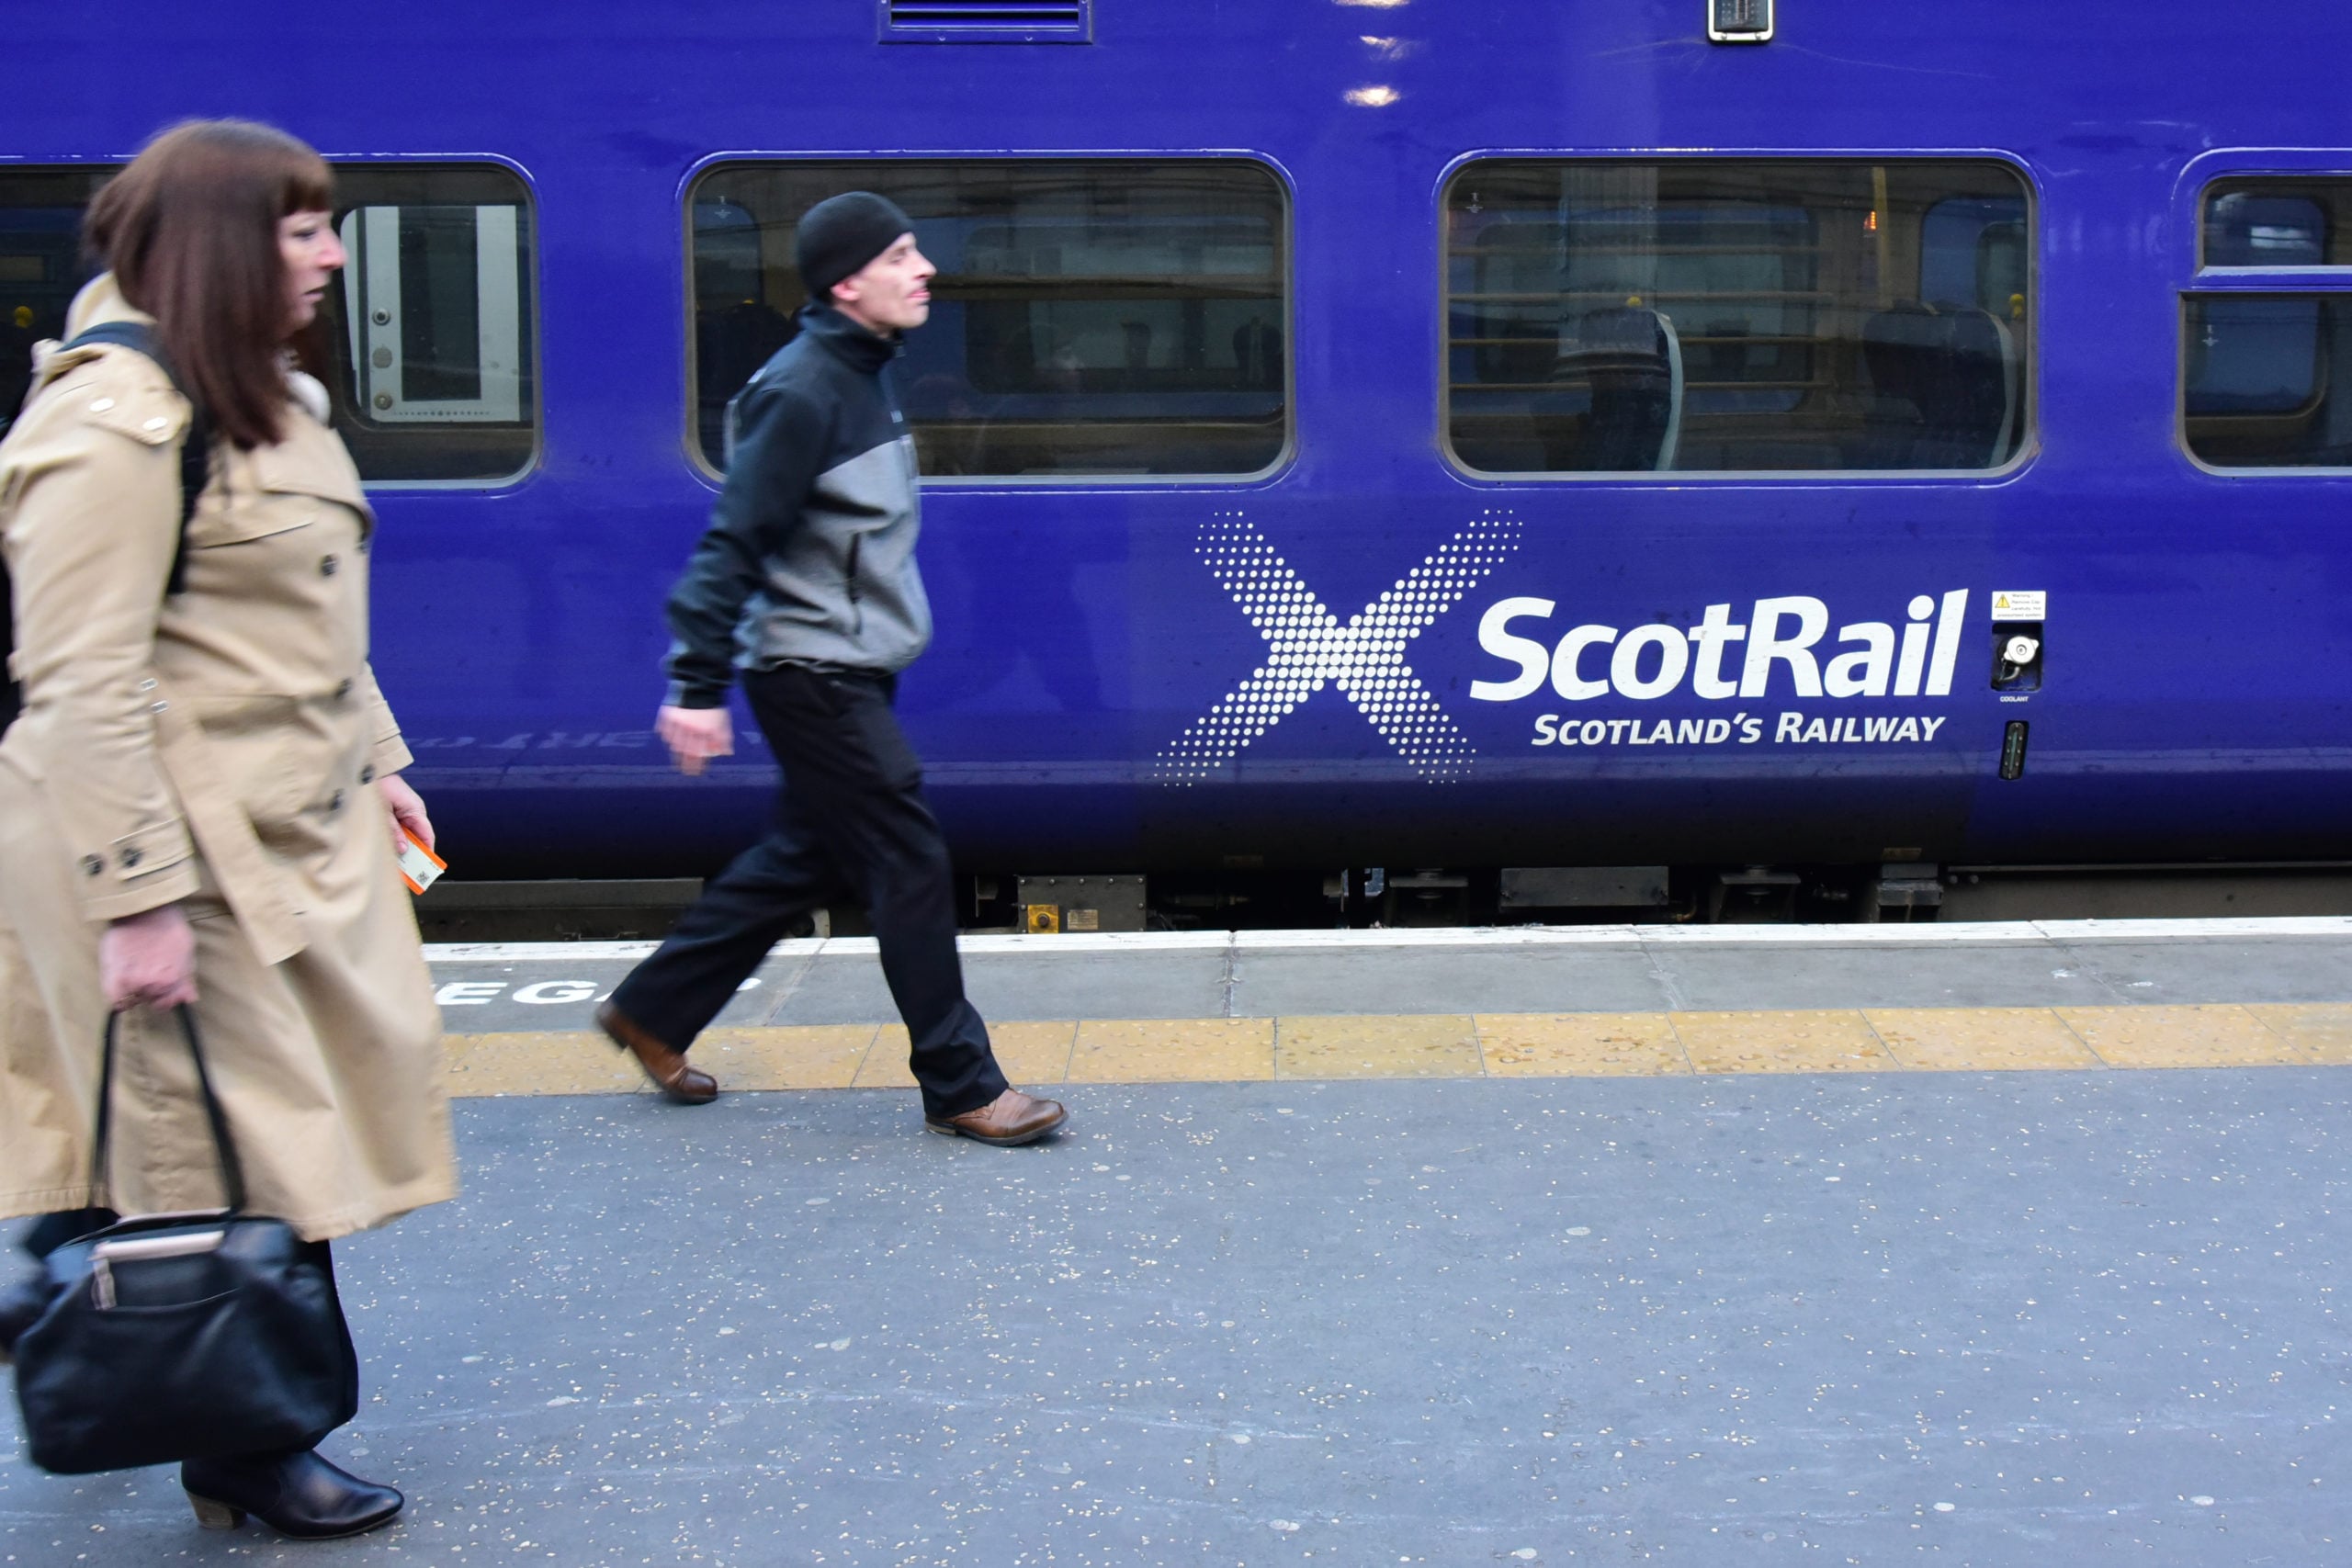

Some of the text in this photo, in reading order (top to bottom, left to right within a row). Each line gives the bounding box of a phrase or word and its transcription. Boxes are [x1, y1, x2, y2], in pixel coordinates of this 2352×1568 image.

[1469, 588, 1969, 702] ScotRail
[1999, 695, 2030, 704] COOLANT
[1531, 711, 1946, 746] SCOTLAND'S RAILWAY
